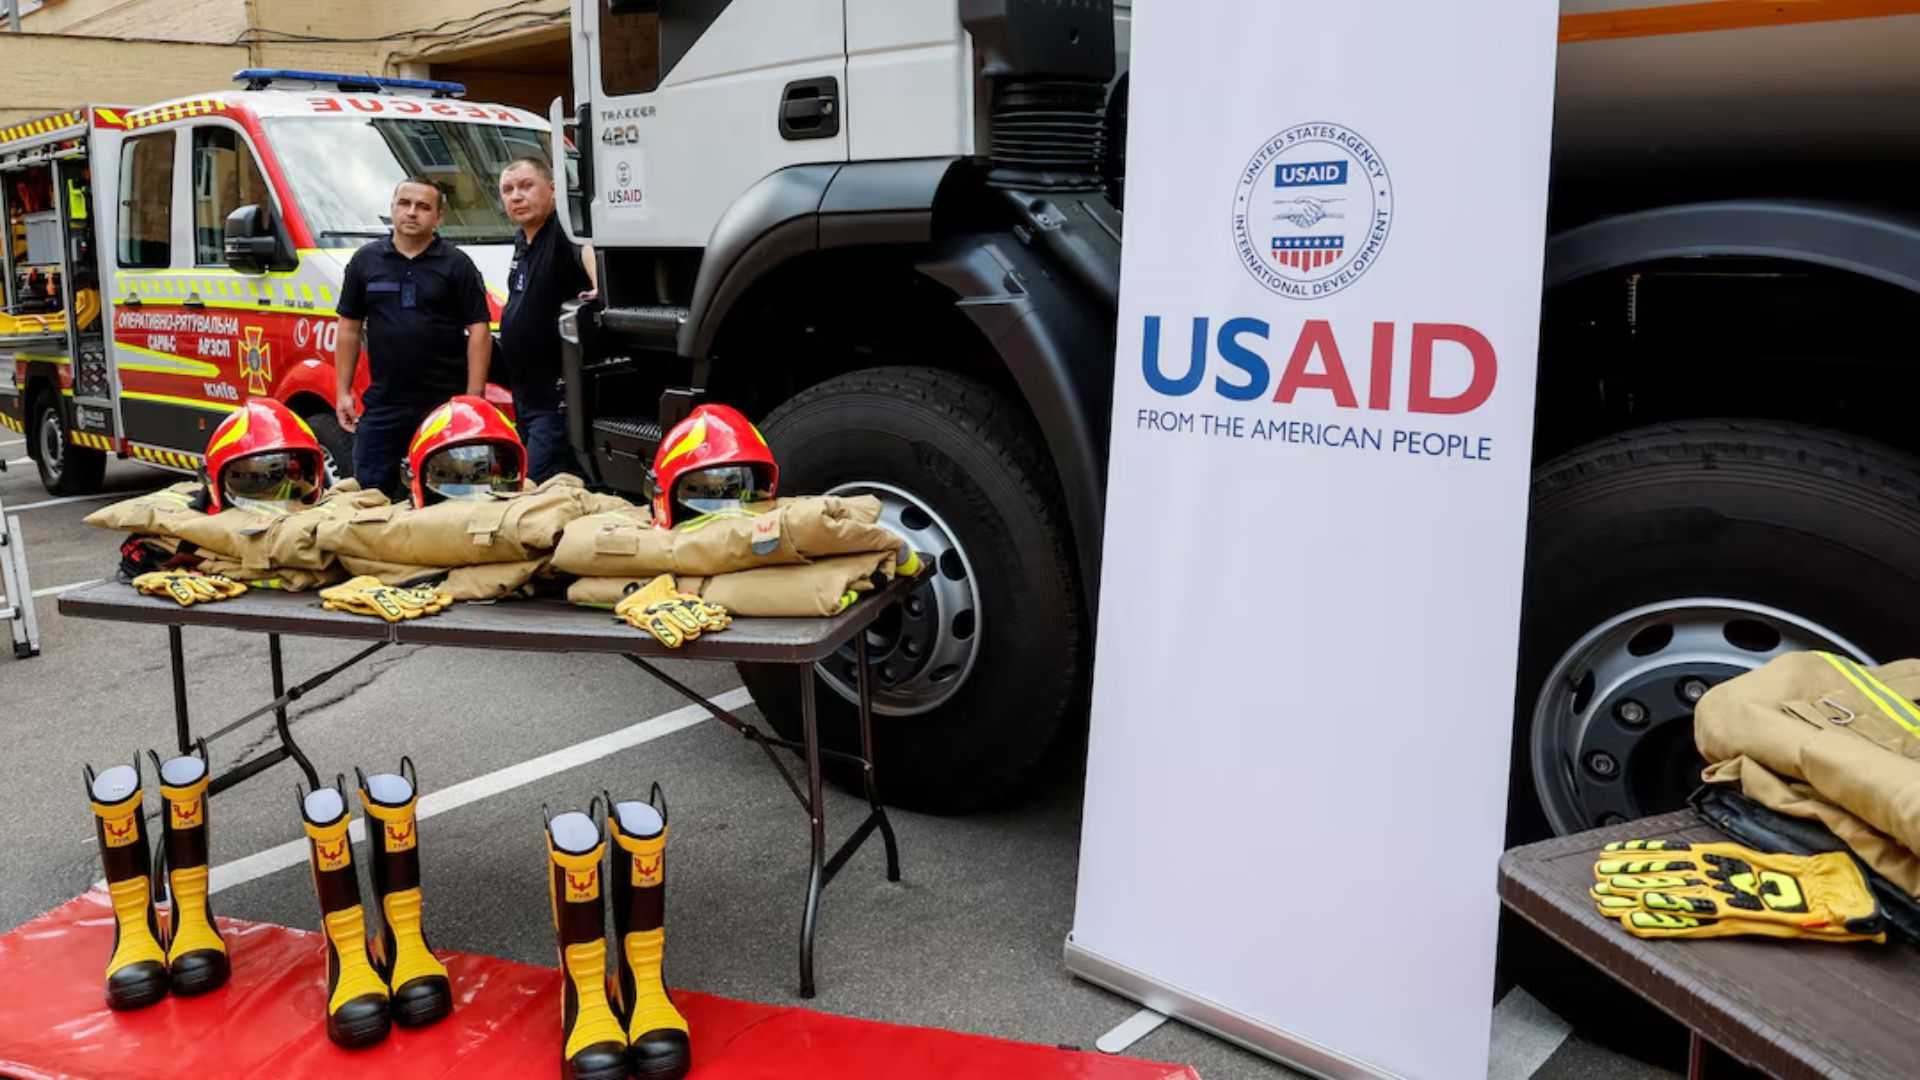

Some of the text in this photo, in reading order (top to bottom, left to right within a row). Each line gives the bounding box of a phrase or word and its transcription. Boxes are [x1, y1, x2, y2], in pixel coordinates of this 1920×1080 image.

[602, 125, 639, 146] 420
[1243, 126, 1384, 185] UNITED STATES AGENCY
[1281, 165, 1340, 183] USAID
[608, 188, 642, 203] USAID
[1236, 209, 1388, 295] INTERNATIONAL DEVELOPMENT
[312, 320, 337, 352] 10
[1141, 315, 1498, 415] USAID
[203, 381, 239, 401] КИЇВ
[1136, 409, 1493, 461] FROM THE AMERICAN PEOPLE
